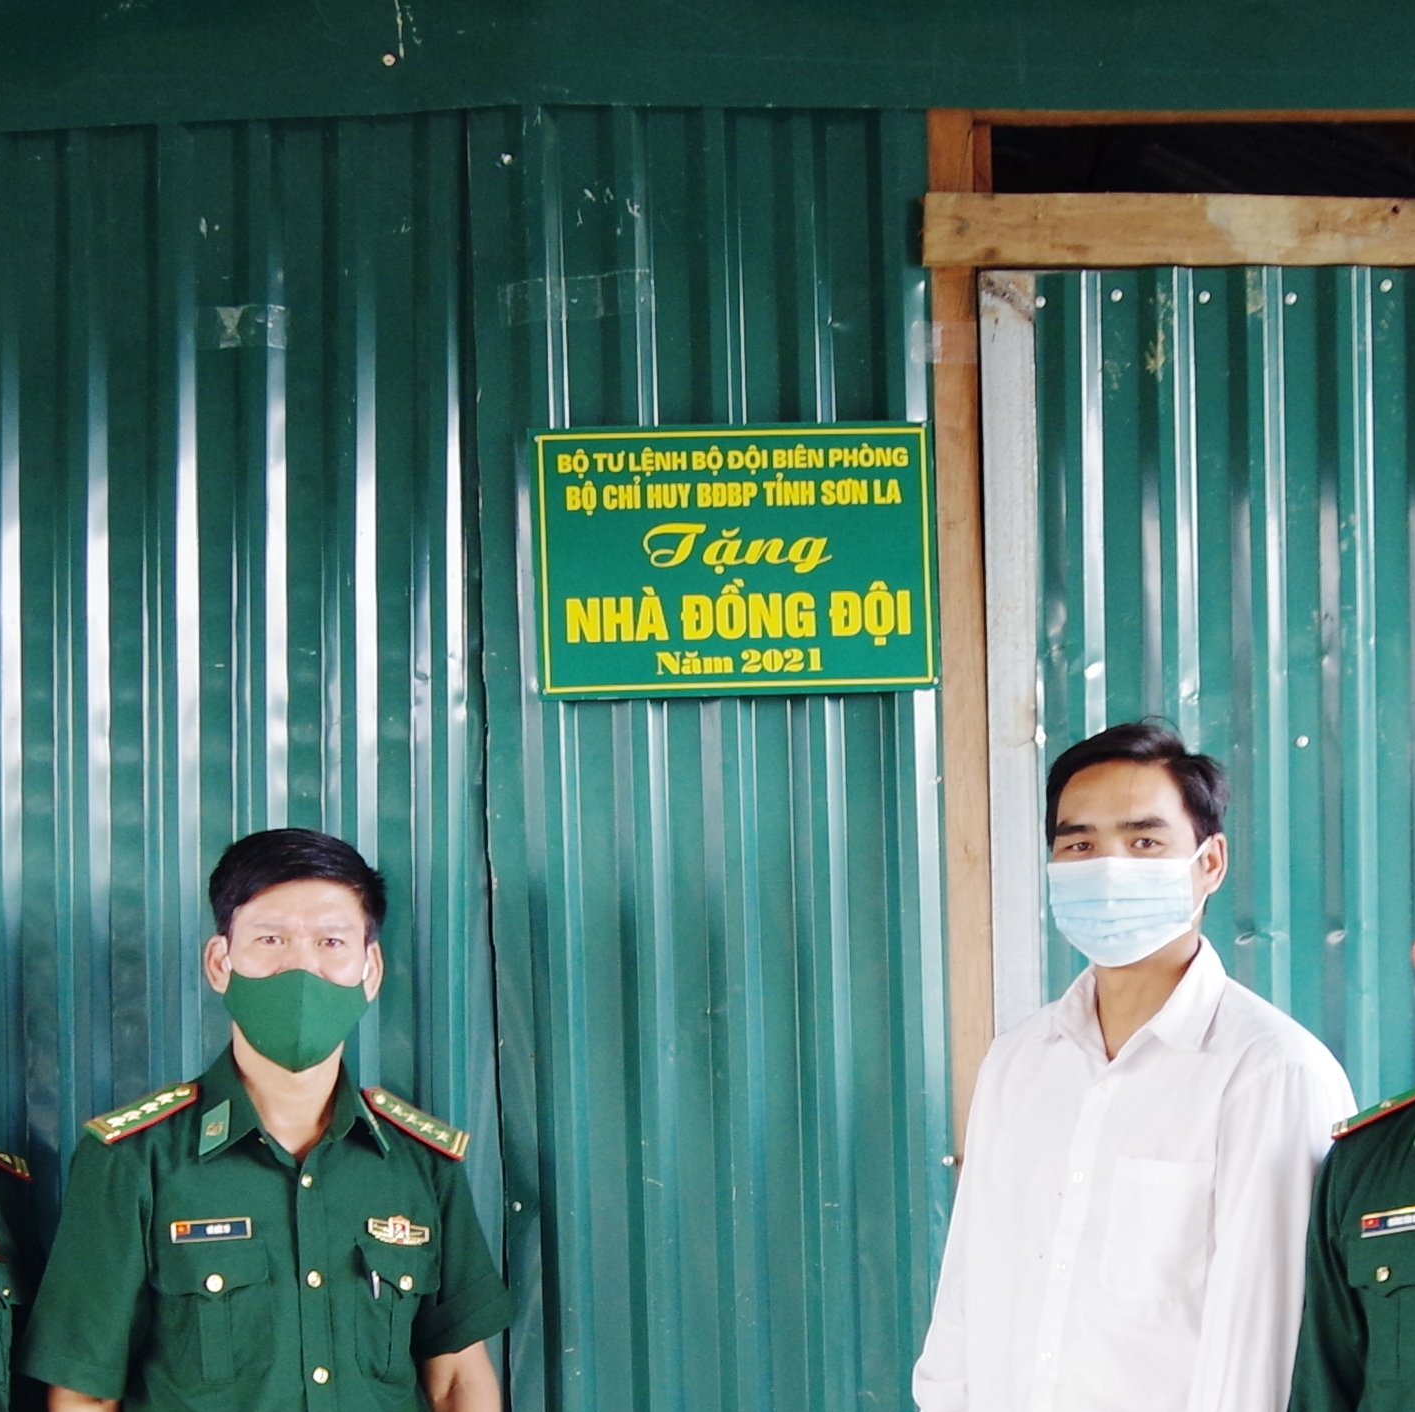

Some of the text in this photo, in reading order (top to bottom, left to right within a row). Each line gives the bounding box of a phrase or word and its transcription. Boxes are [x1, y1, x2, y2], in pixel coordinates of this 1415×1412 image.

[557, 444, 908, 479] BỘ TƯ LỆNH BỘ ĐỘI BIÊN PHÒNG
[566, 472, 902, 516] BỘ CHỈ HUY BĐBP TỈNH SƠN LA
[643, 523, 832, 574] Tặng
[566, 578, 911, 646] NHÀ ĐỒNG ĐỘI
[656, 648, 823, 675] Năm 2021
